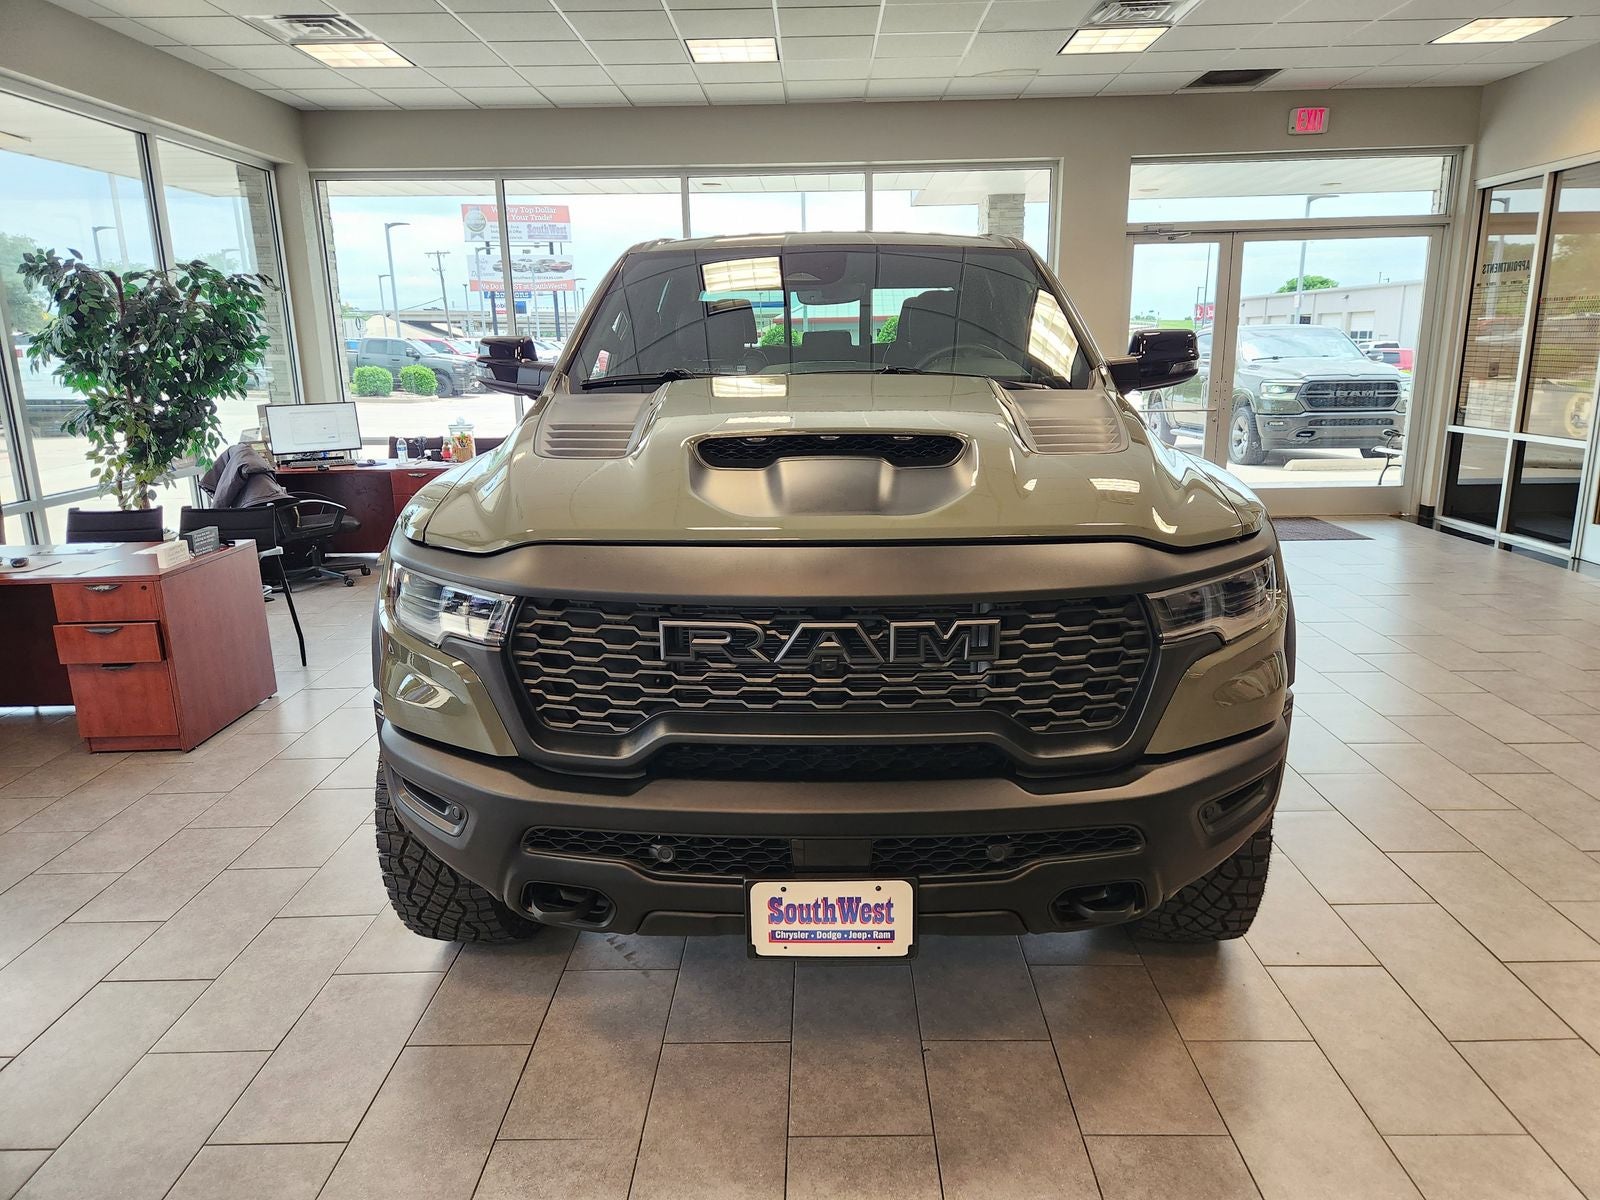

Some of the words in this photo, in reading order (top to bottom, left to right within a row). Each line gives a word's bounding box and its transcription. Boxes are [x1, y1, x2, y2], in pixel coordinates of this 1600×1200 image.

[1297, 108, 1326, 131] EXIT
[520, 207, 534, 215] Top
[527, 224, 567, 234] SouthWest
[1334, 390, 1376, 398] RAM
[659, 618, 1001, 664] RAM
[768, 896, 895, 925] SouthWest
[775, 930, 809, 941] Chrysler
[816, 930, 842, 940] Dodge
[848, 931, 869, 941] Jeep
[873, 930, 891, 940] Ram
